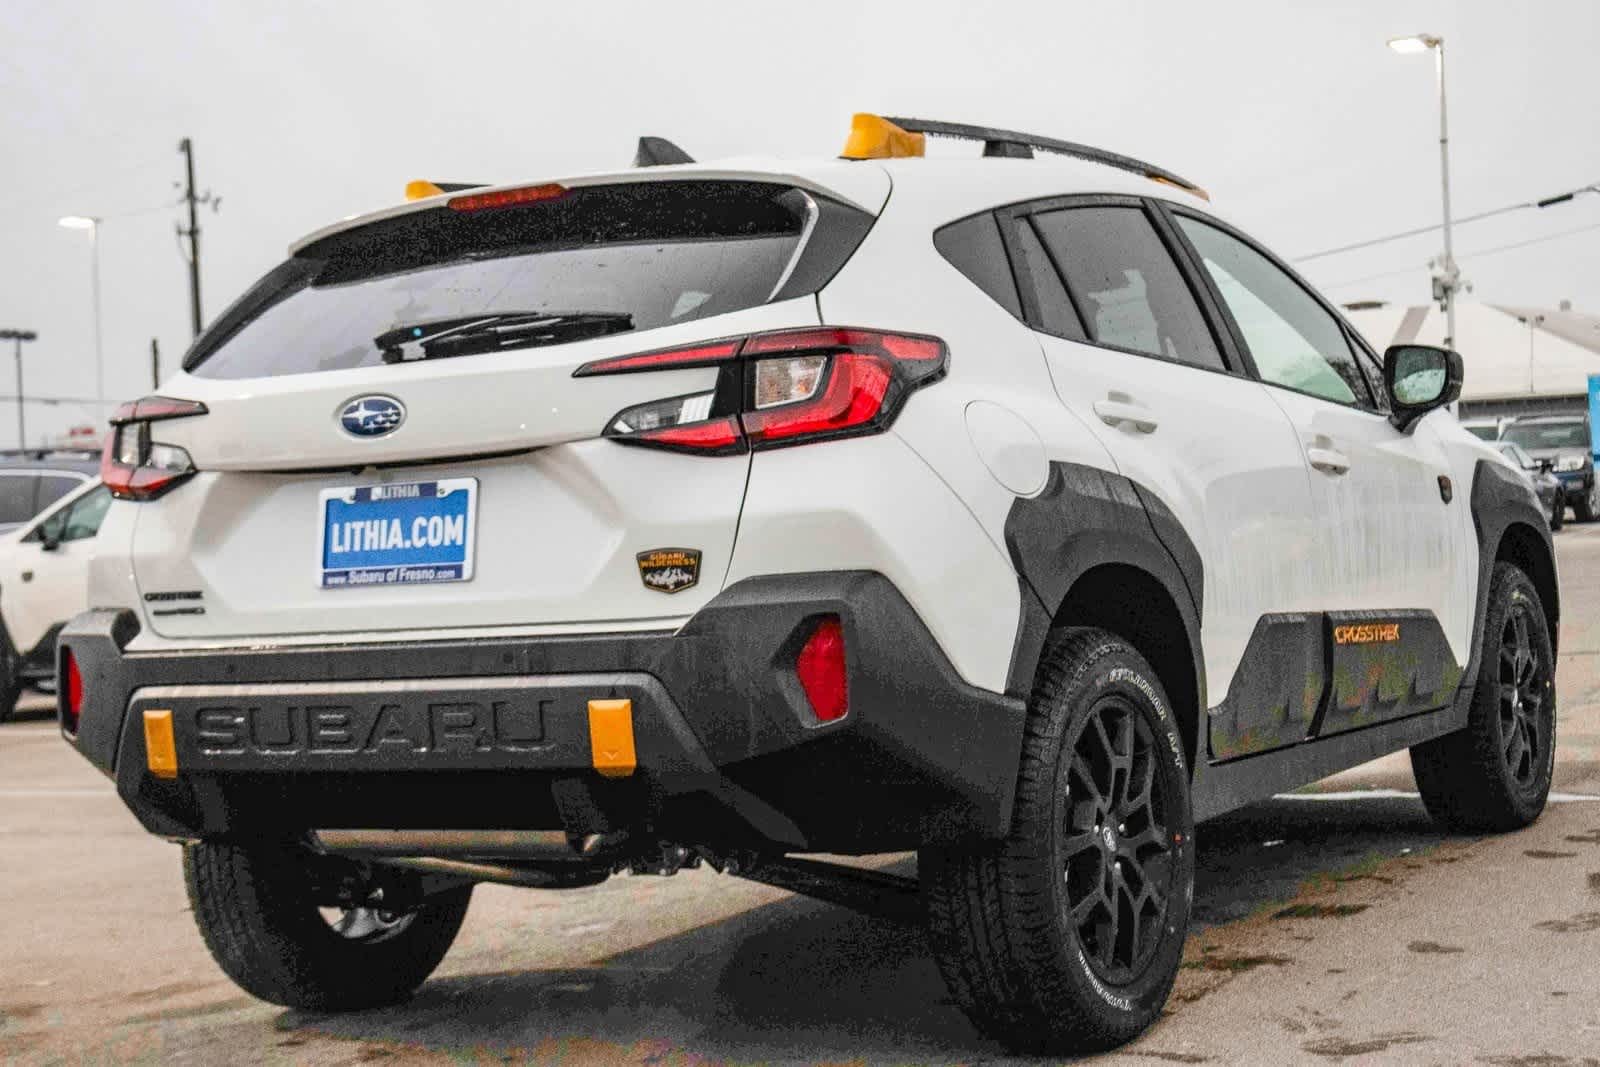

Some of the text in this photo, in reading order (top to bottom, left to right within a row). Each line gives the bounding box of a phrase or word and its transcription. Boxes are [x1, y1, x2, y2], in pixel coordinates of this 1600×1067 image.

[382, 485, 420, 499] LITHIA
[331, 515, 464, 553] LITHIA.COM
[349, 569, 385, 585] Subaru
[386, 568, 397, 583] of
[195, 700, 556, 755] SUBARU
